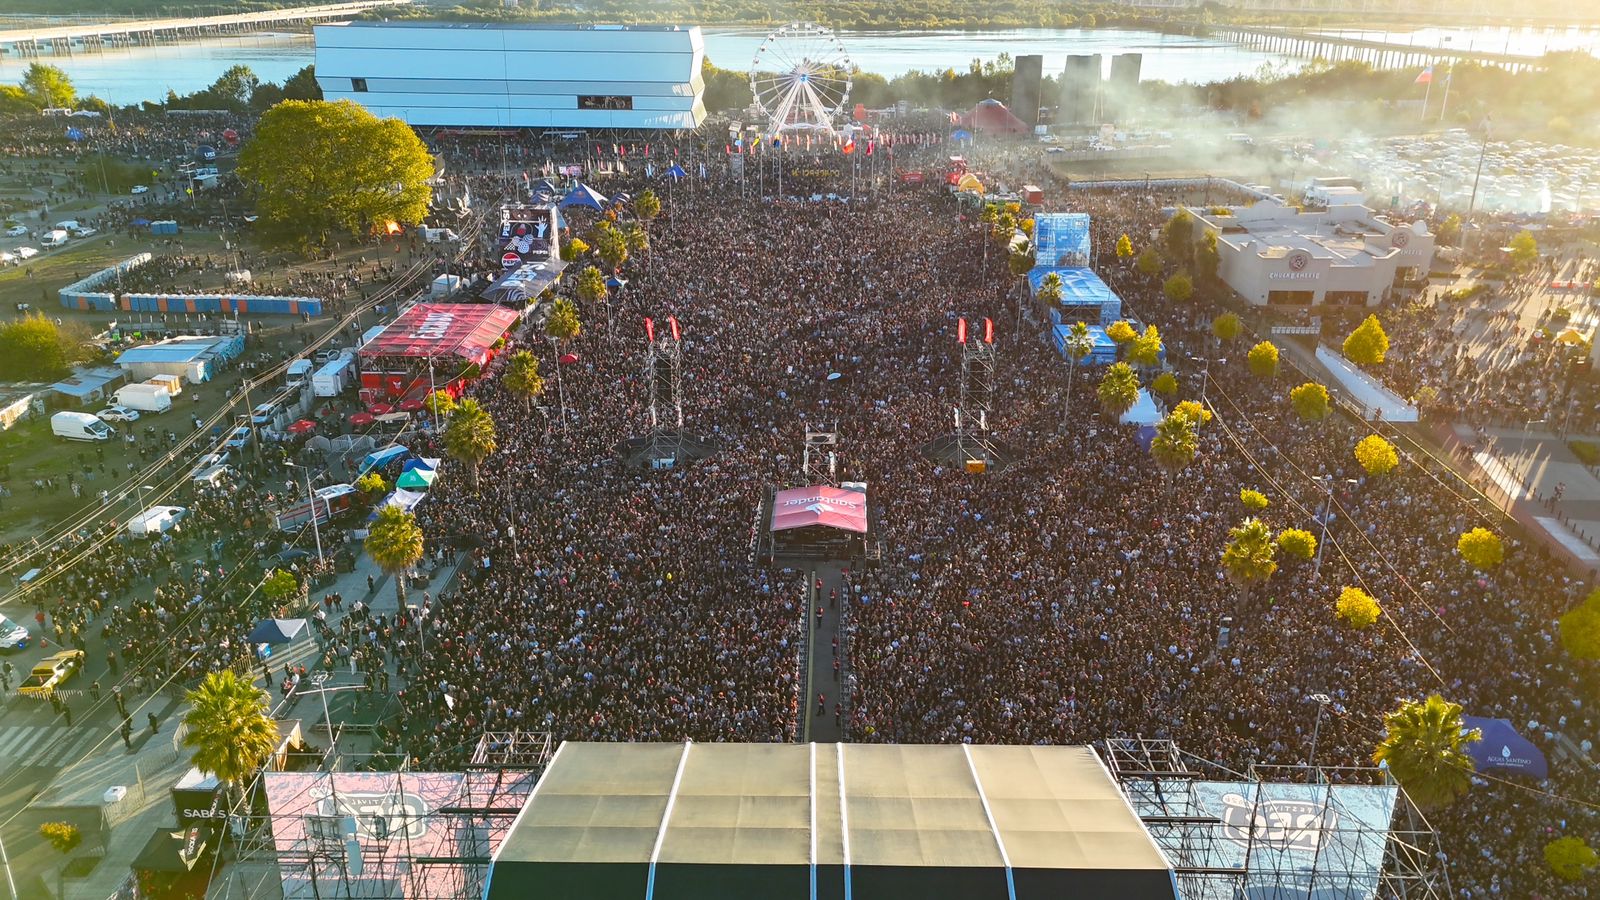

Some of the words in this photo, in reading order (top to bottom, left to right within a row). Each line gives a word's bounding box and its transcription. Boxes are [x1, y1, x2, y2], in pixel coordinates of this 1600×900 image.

[502, 209, 511, 237] PEPSI
[783, 495, 857, 509] Santander
[183, 808, 226, 819] SABS
